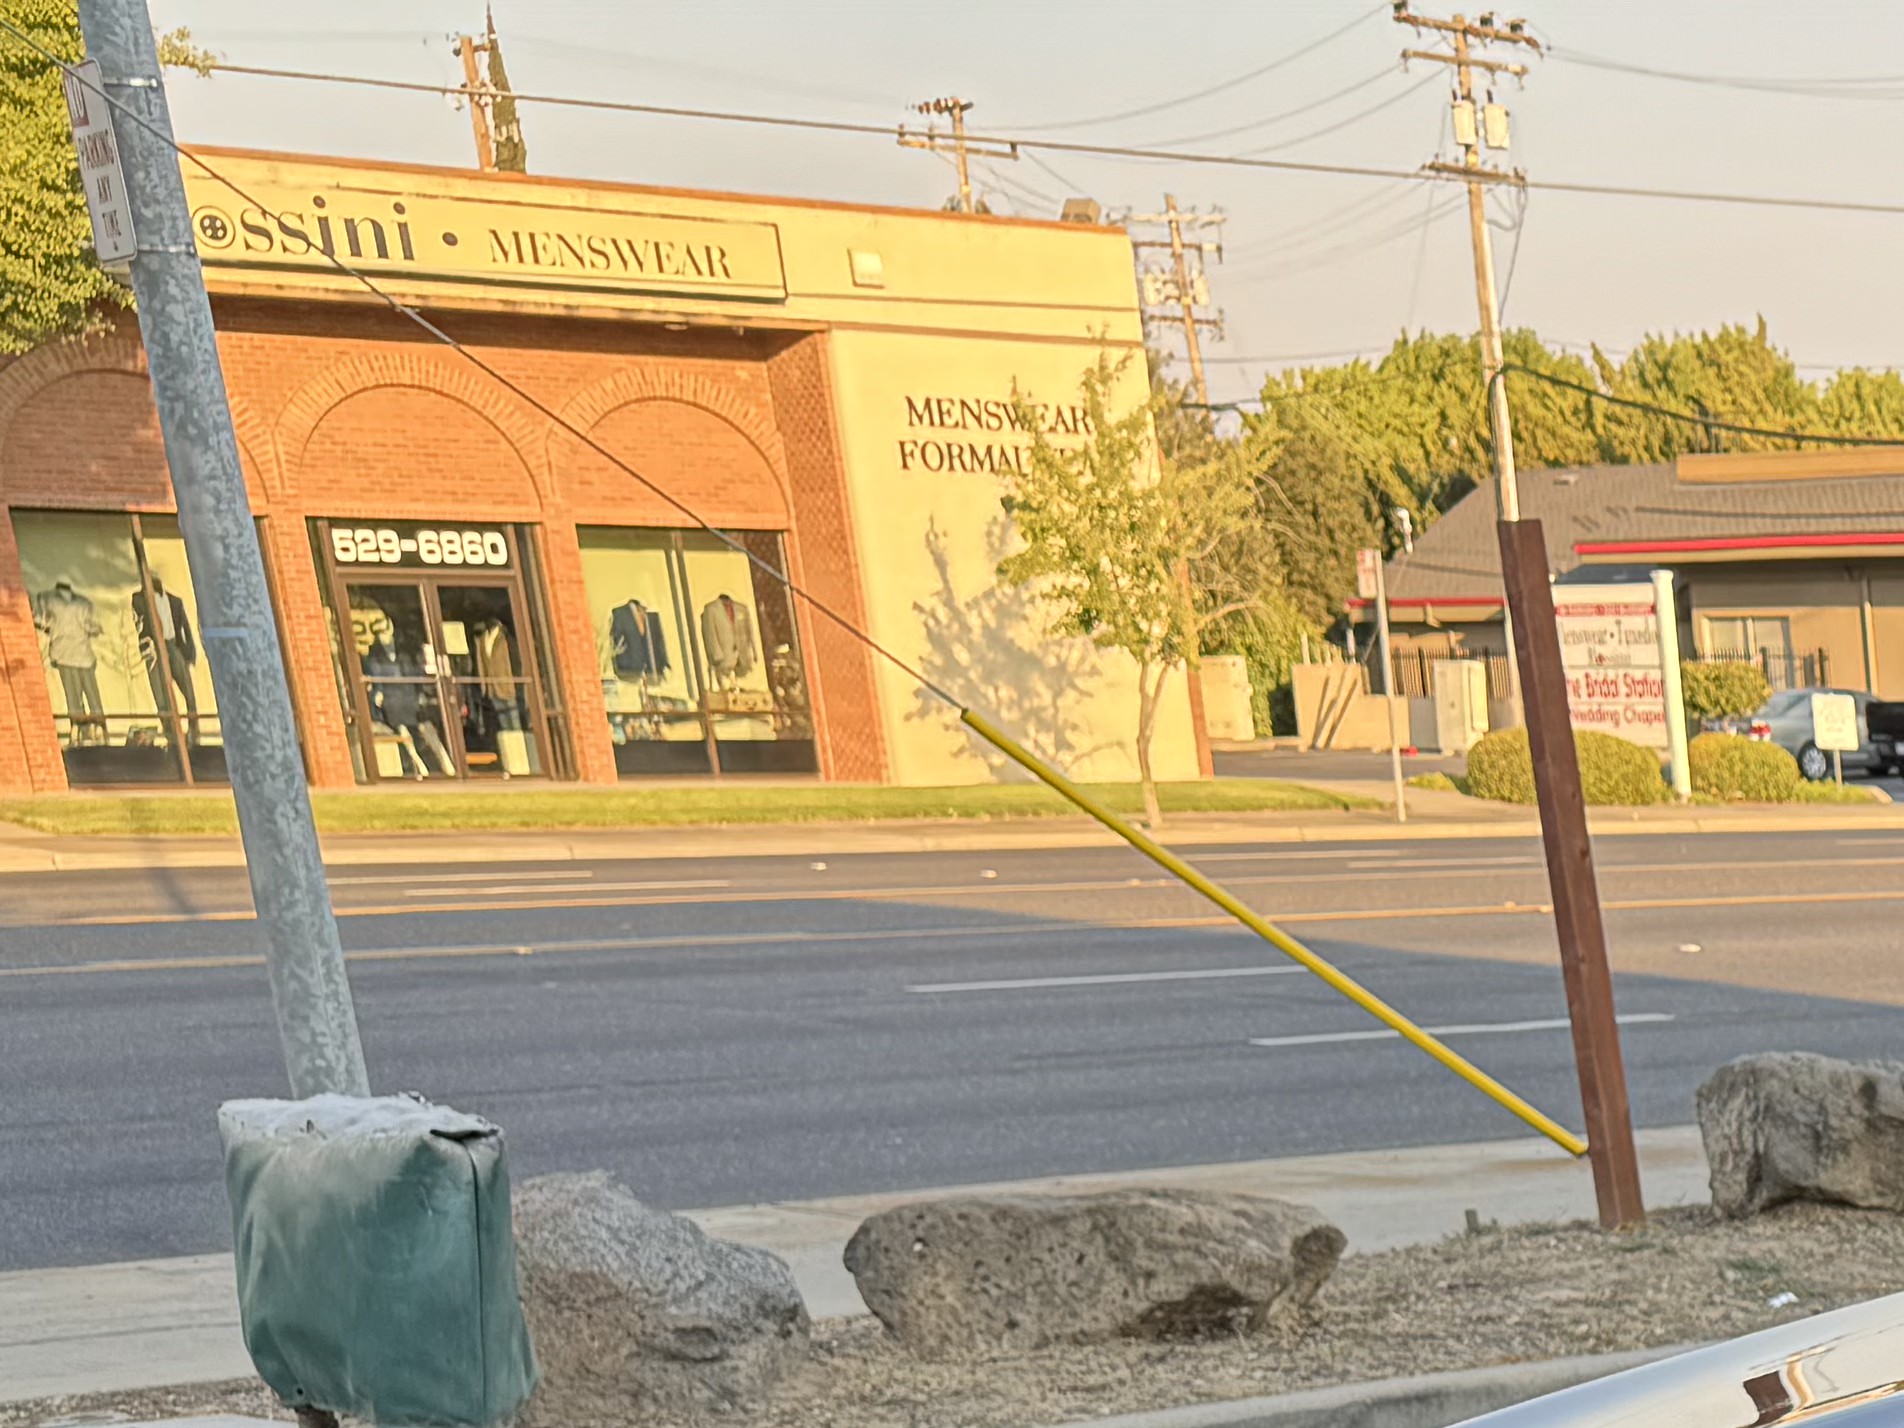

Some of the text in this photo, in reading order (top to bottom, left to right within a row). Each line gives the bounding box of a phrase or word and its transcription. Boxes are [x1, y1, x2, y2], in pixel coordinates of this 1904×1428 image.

[191, 194, 733, 280] ossini MENSWEAR
[904, 395, 1093, 436] MENSWEAR
[331, 527, 508, 566] 529-6860
